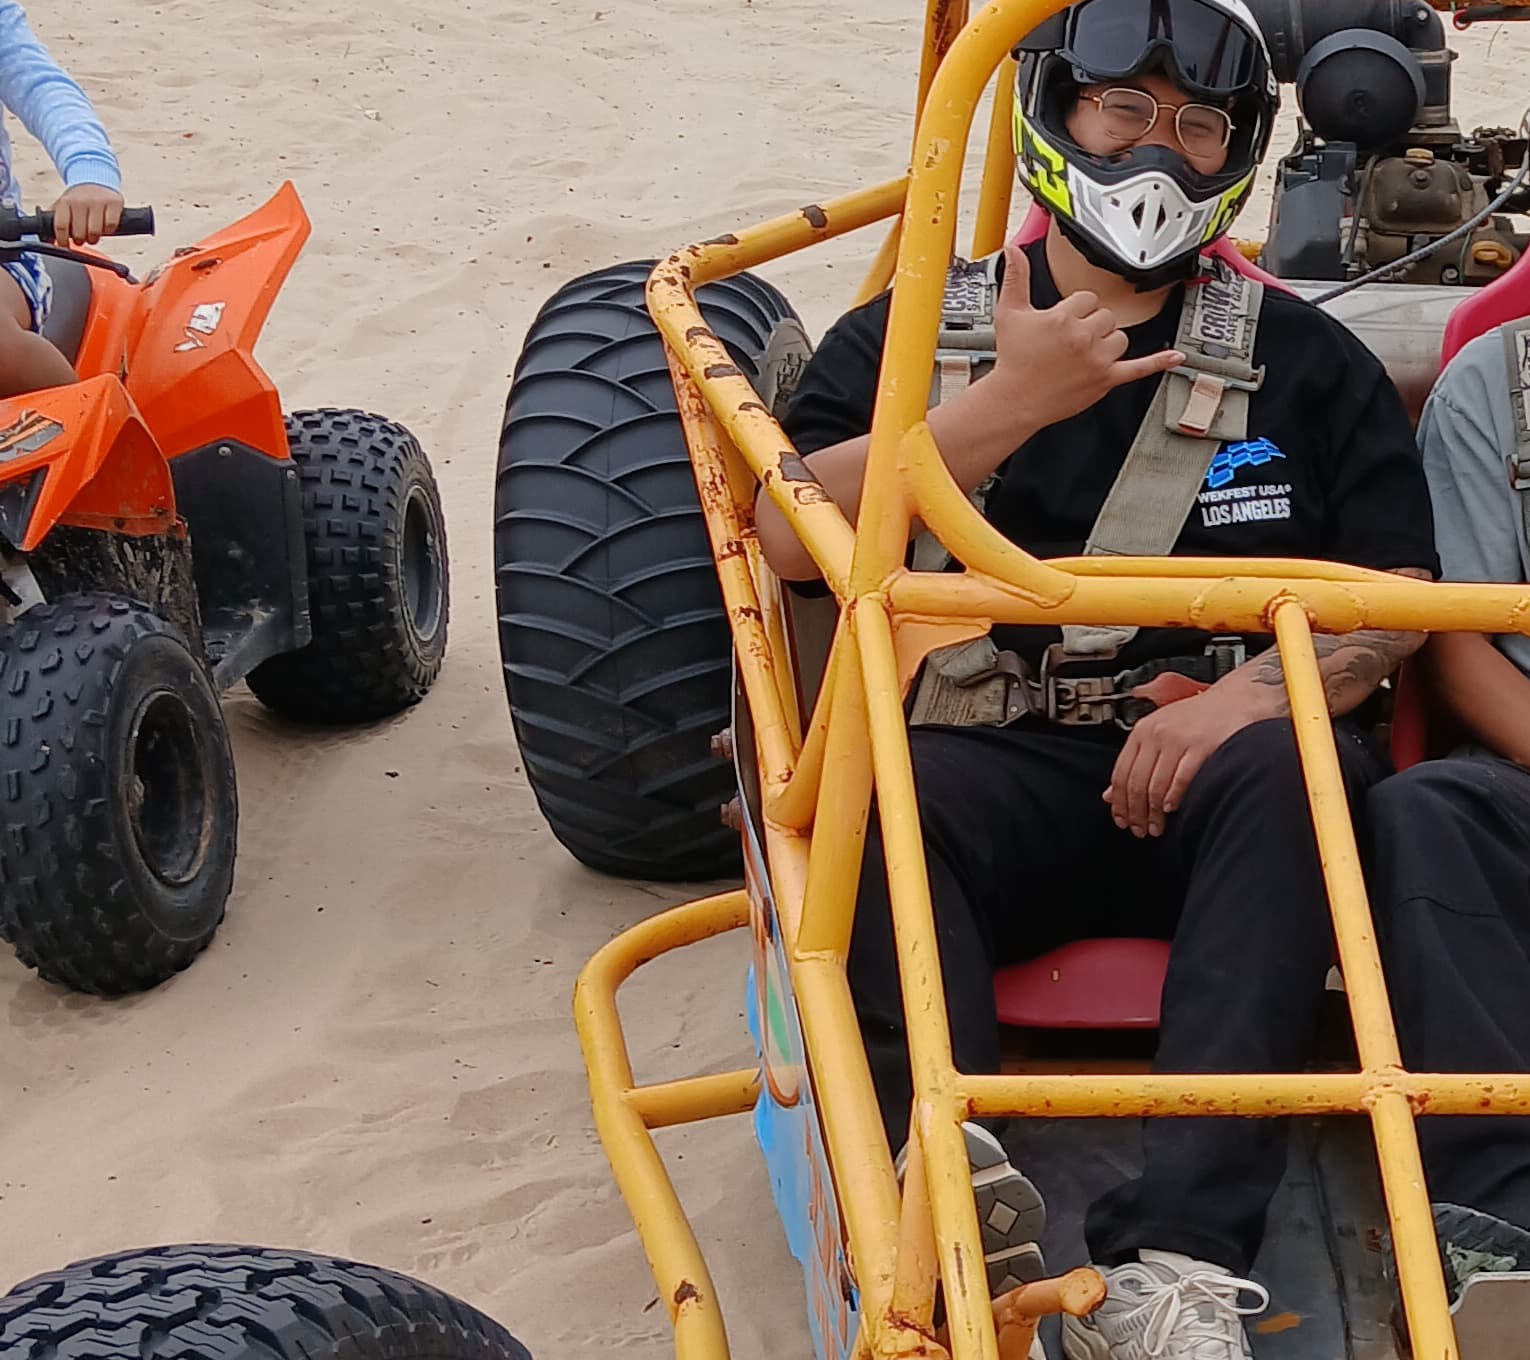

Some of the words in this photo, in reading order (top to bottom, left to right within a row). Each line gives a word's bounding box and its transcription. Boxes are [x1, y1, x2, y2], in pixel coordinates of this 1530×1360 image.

[1199, 486, 1257, 504] WEKFEST
[1202, 504, 1232, 528] LOS
[1232, 498, 1291, 523] ANGELES
